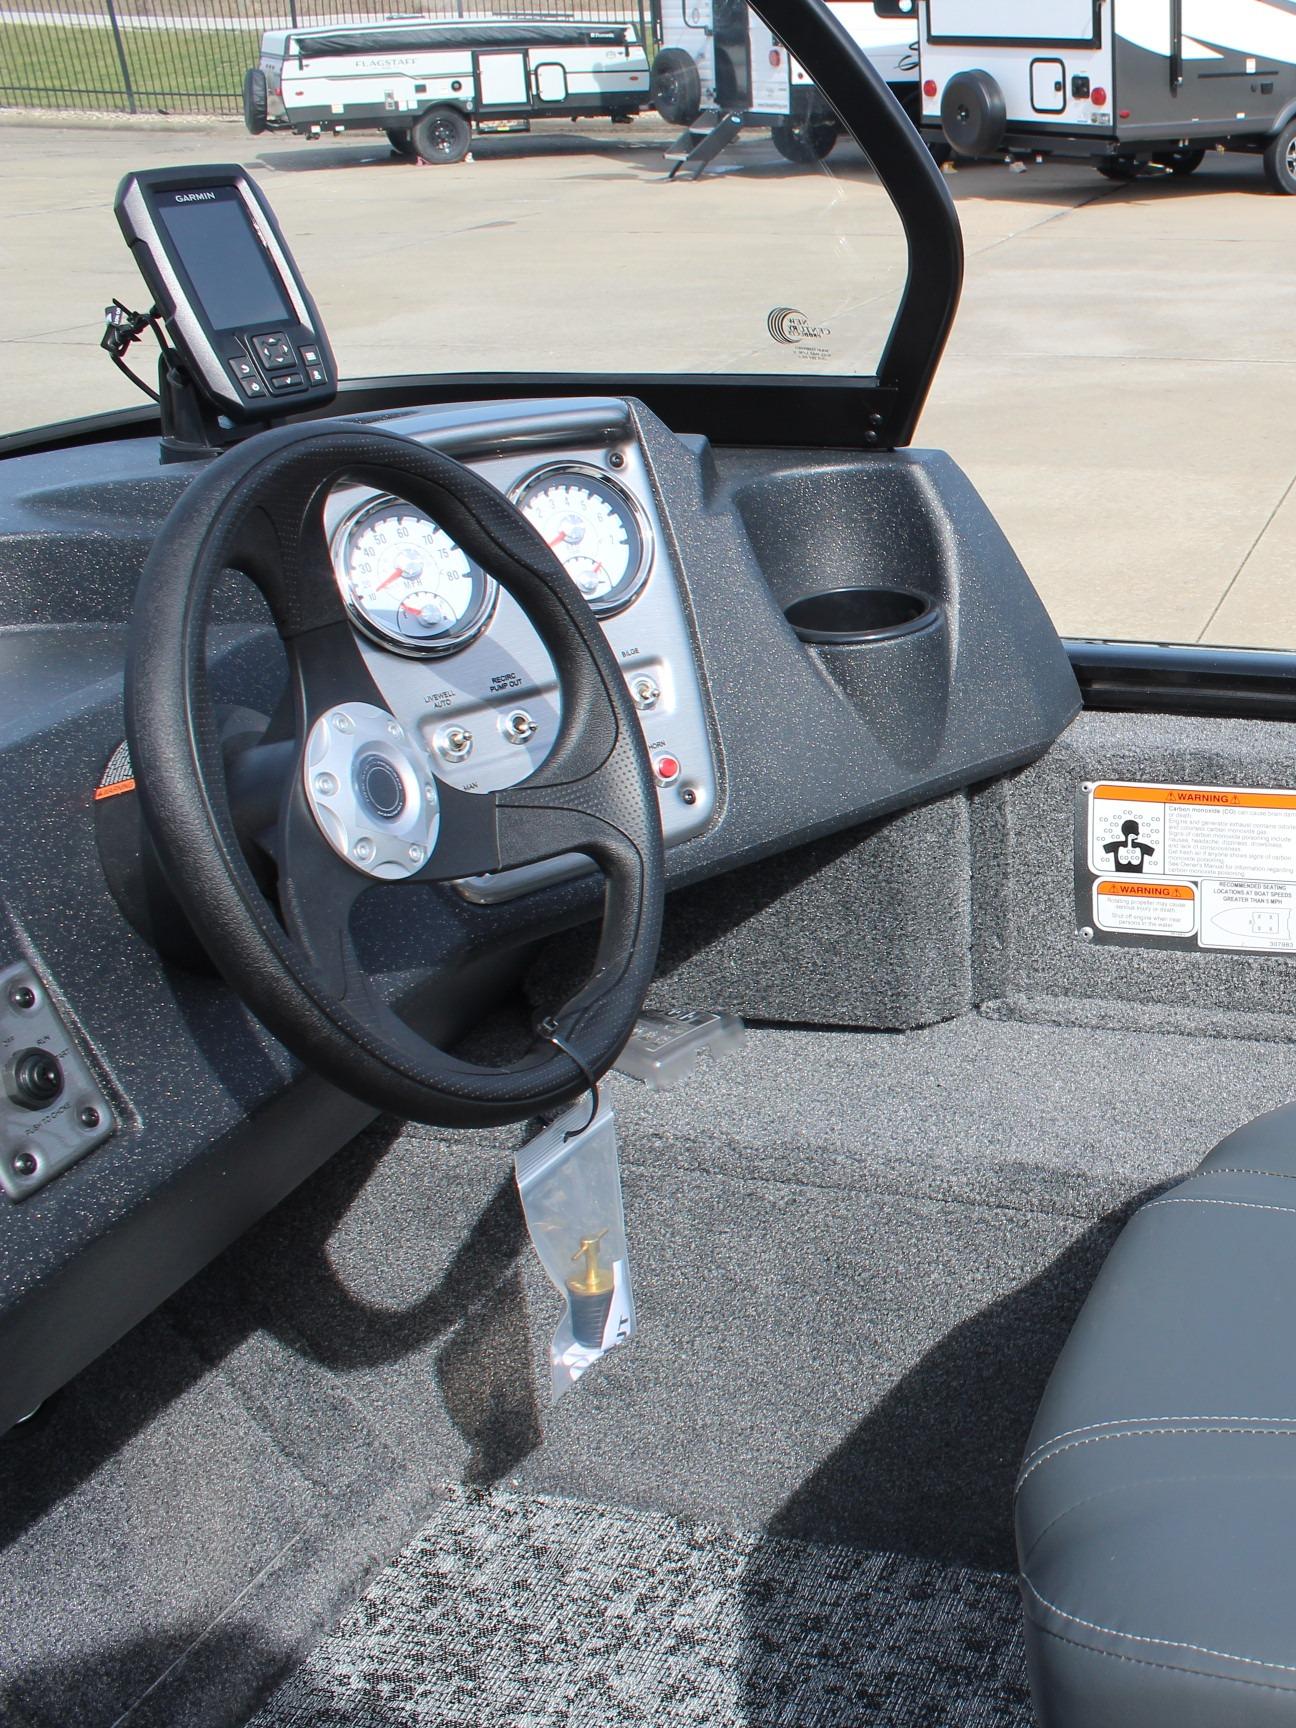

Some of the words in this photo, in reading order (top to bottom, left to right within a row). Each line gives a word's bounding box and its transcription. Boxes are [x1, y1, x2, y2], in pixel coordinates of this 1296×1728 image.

[175, 192, 217, 203] GARMIN
[396, 526, 410, 539] 60
[373, 532, 388, 546] 50
[422, 533, 435, 546] 70
[363, 546, 377, 559] 40
[439, 548, 450, 560] 75
[359, 562, 373, 575] 30
[447, 571, 460, 582] 80
[621, 648, 640, 658] BILGE
[491, 672, 516, 684] RECIRC
[489, 683, 508, 692] PUMP
[509, 678, 522, 688] OUT
[423, 690, 456, 703] LIVEWELL
[433, 699, 452, 708] AUTO
[1177, 792, 1229, 803] WARNING
[1120, 885, 1170, 896] WARNING
[1219, 881, 1261, 889] RECOMMENDED
[1213, 888, 1245, 896] LOCATIONS
